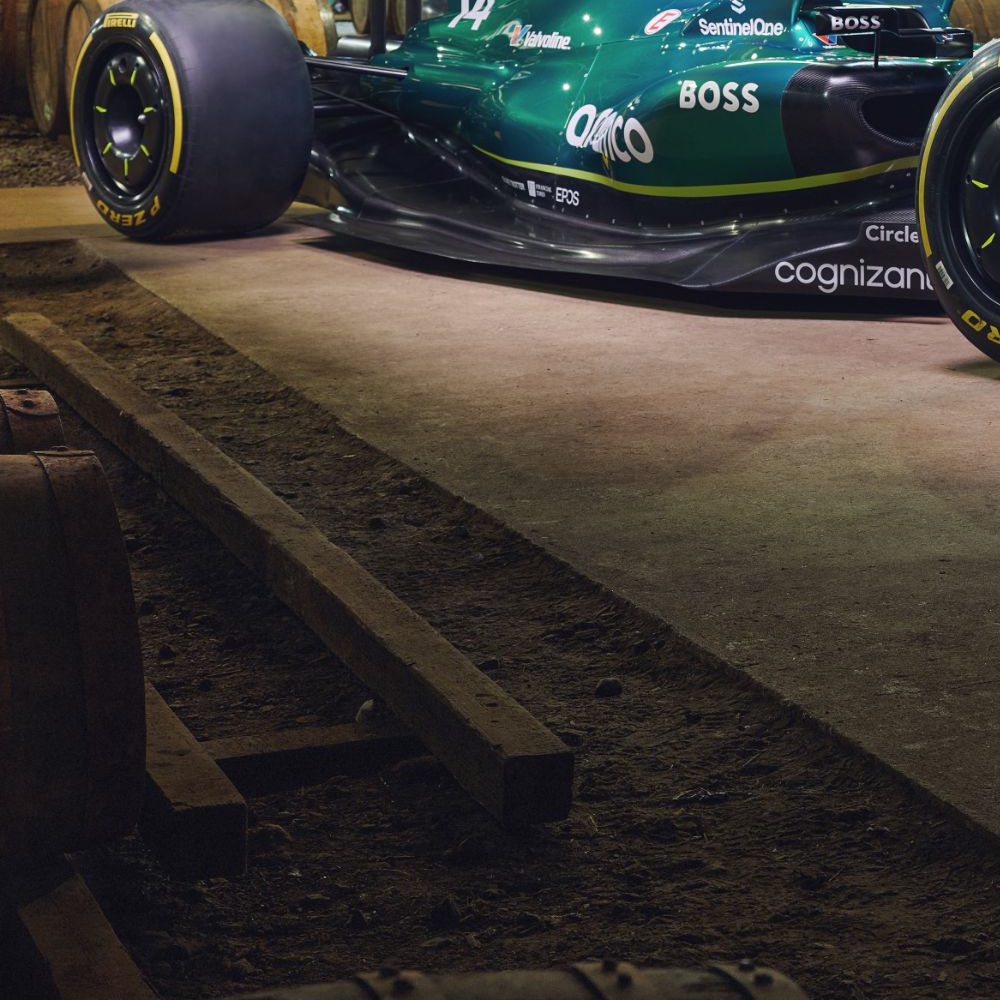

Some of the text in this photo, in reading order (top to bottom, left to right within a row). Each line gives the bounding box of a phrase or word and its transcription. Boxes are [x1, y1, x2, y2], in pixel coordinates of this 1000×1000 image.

[102, 12, 139, 28] PIRELLI
[698, 18, 784, 36] SentinelOne
[831, 15, 881, 31] BOSS
[523, 30, 571, 50] Valvoline
[679, 79, 760, 113] BOSS
[555, 186, 580, 207] EPOS
[96, 194, 161, 227] P ZERO
